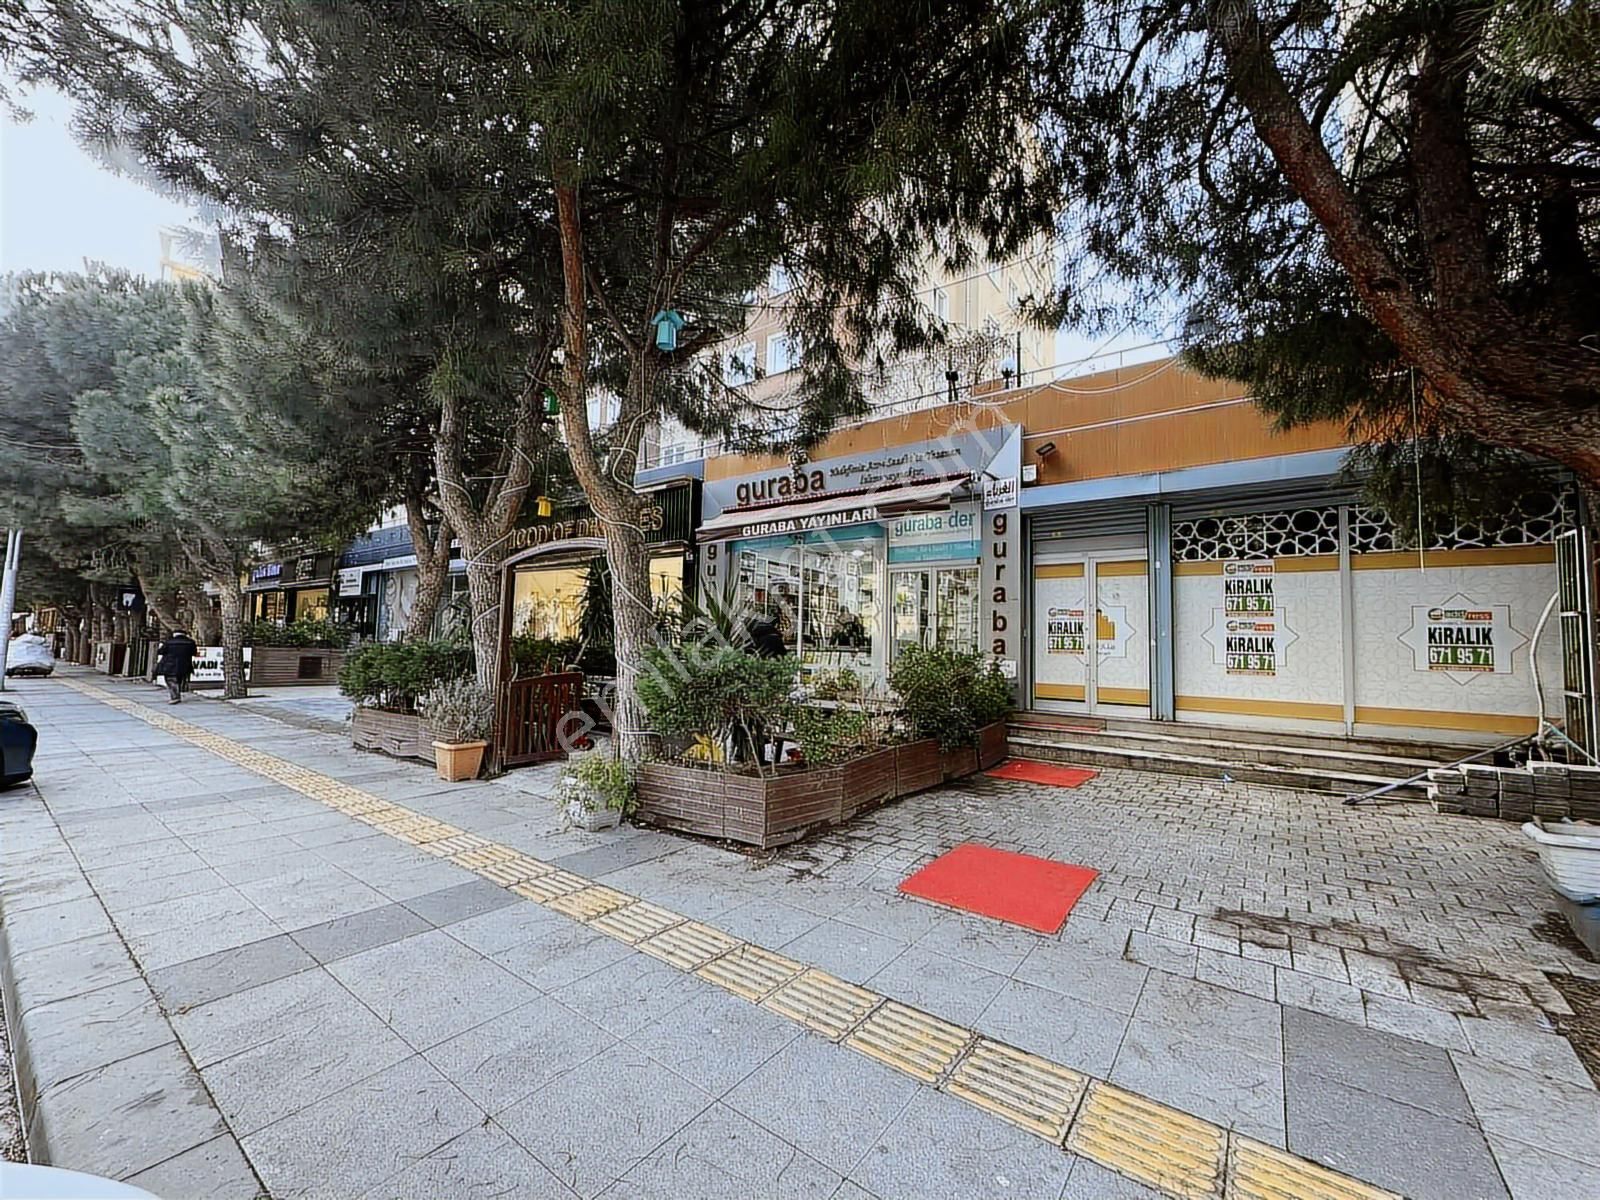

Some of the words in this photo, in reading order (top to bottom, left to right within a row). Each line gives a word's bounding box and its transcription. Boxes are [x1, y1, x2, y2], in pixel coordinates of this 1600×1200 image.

[736, 469, 825, 505] guraba
[743, 519, 795, 537] GURABA
[800, 508, 878, 529] YAYINLARI
[992, 513, 1008, 656] guraba
[1227, 597, 1243, 611] 671
[1247, 597, 1259, 611] 95
[1262, 597, 1273, 611] 71
[1228, 655, 1245, 669] 671
[1248, 655, 1260, 669] 95
[1263, 655, 1274, 669] 71
[1430, 647, 1452, 663] 671
[1457, 648, 1473, 664] 95
[1477, 648, 1492, 664] 71
